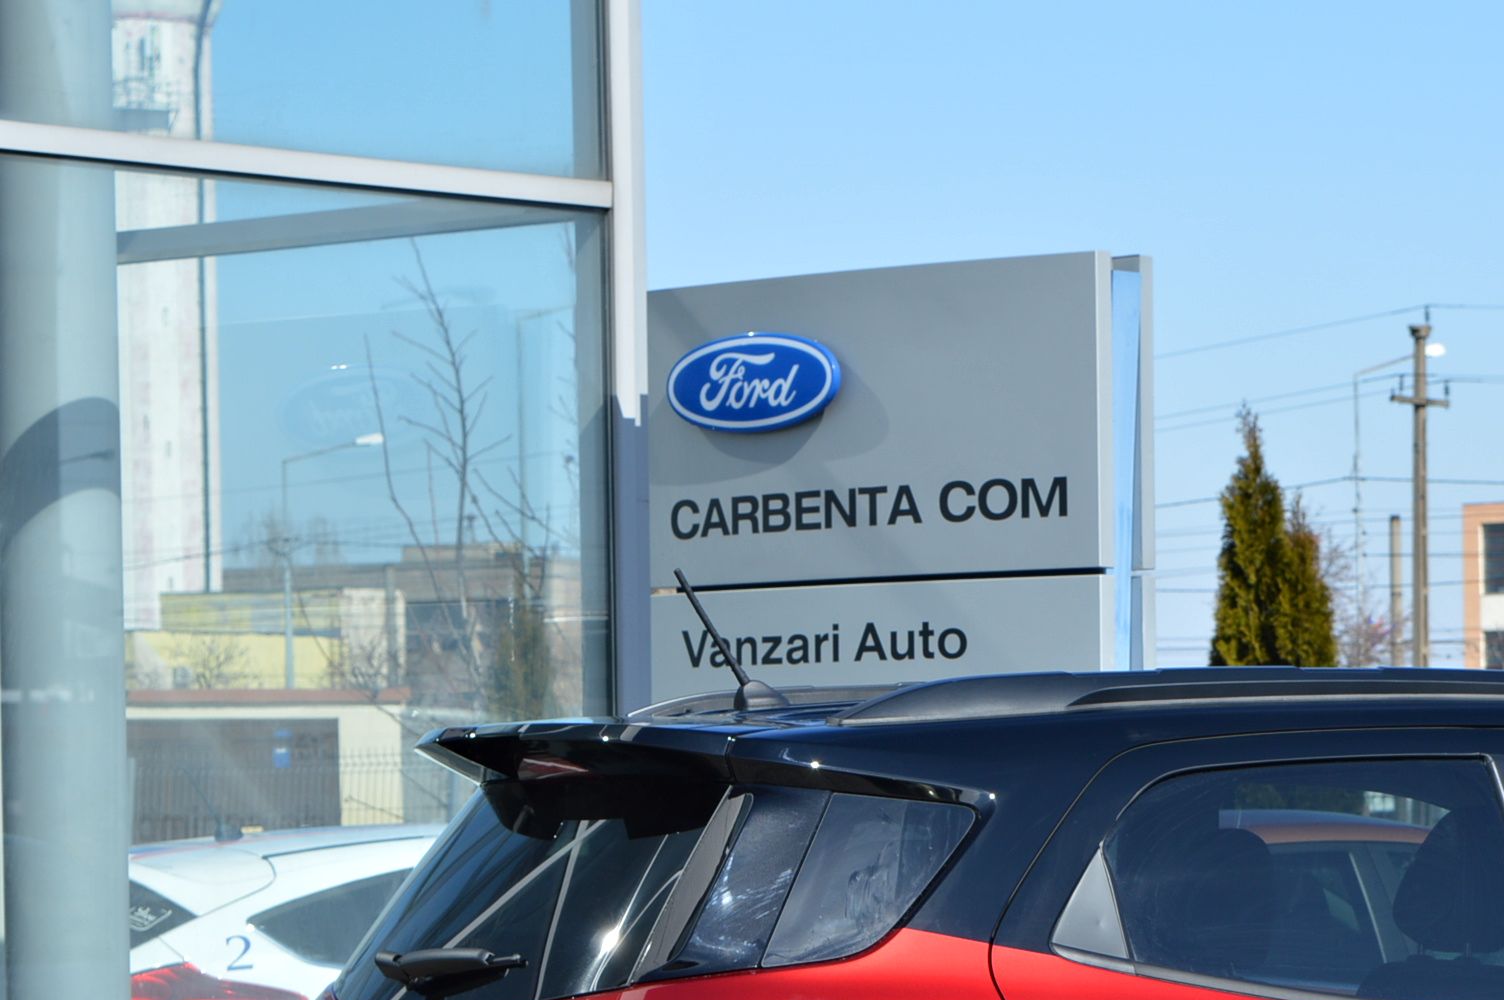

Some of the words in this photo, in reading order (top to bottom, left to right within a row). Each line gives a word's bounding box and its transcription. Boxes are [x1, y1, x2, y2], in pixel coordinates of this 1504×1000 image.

[700, 352, 799, 411] Ford
[671, 484, 923, 540] CARBENTA
[939, 476, 1068, 523] COM
[681, 623, 840, 668] Vanzari
[854, 621, 967, 661] Auto
[226, 934, 253, 971] 2
